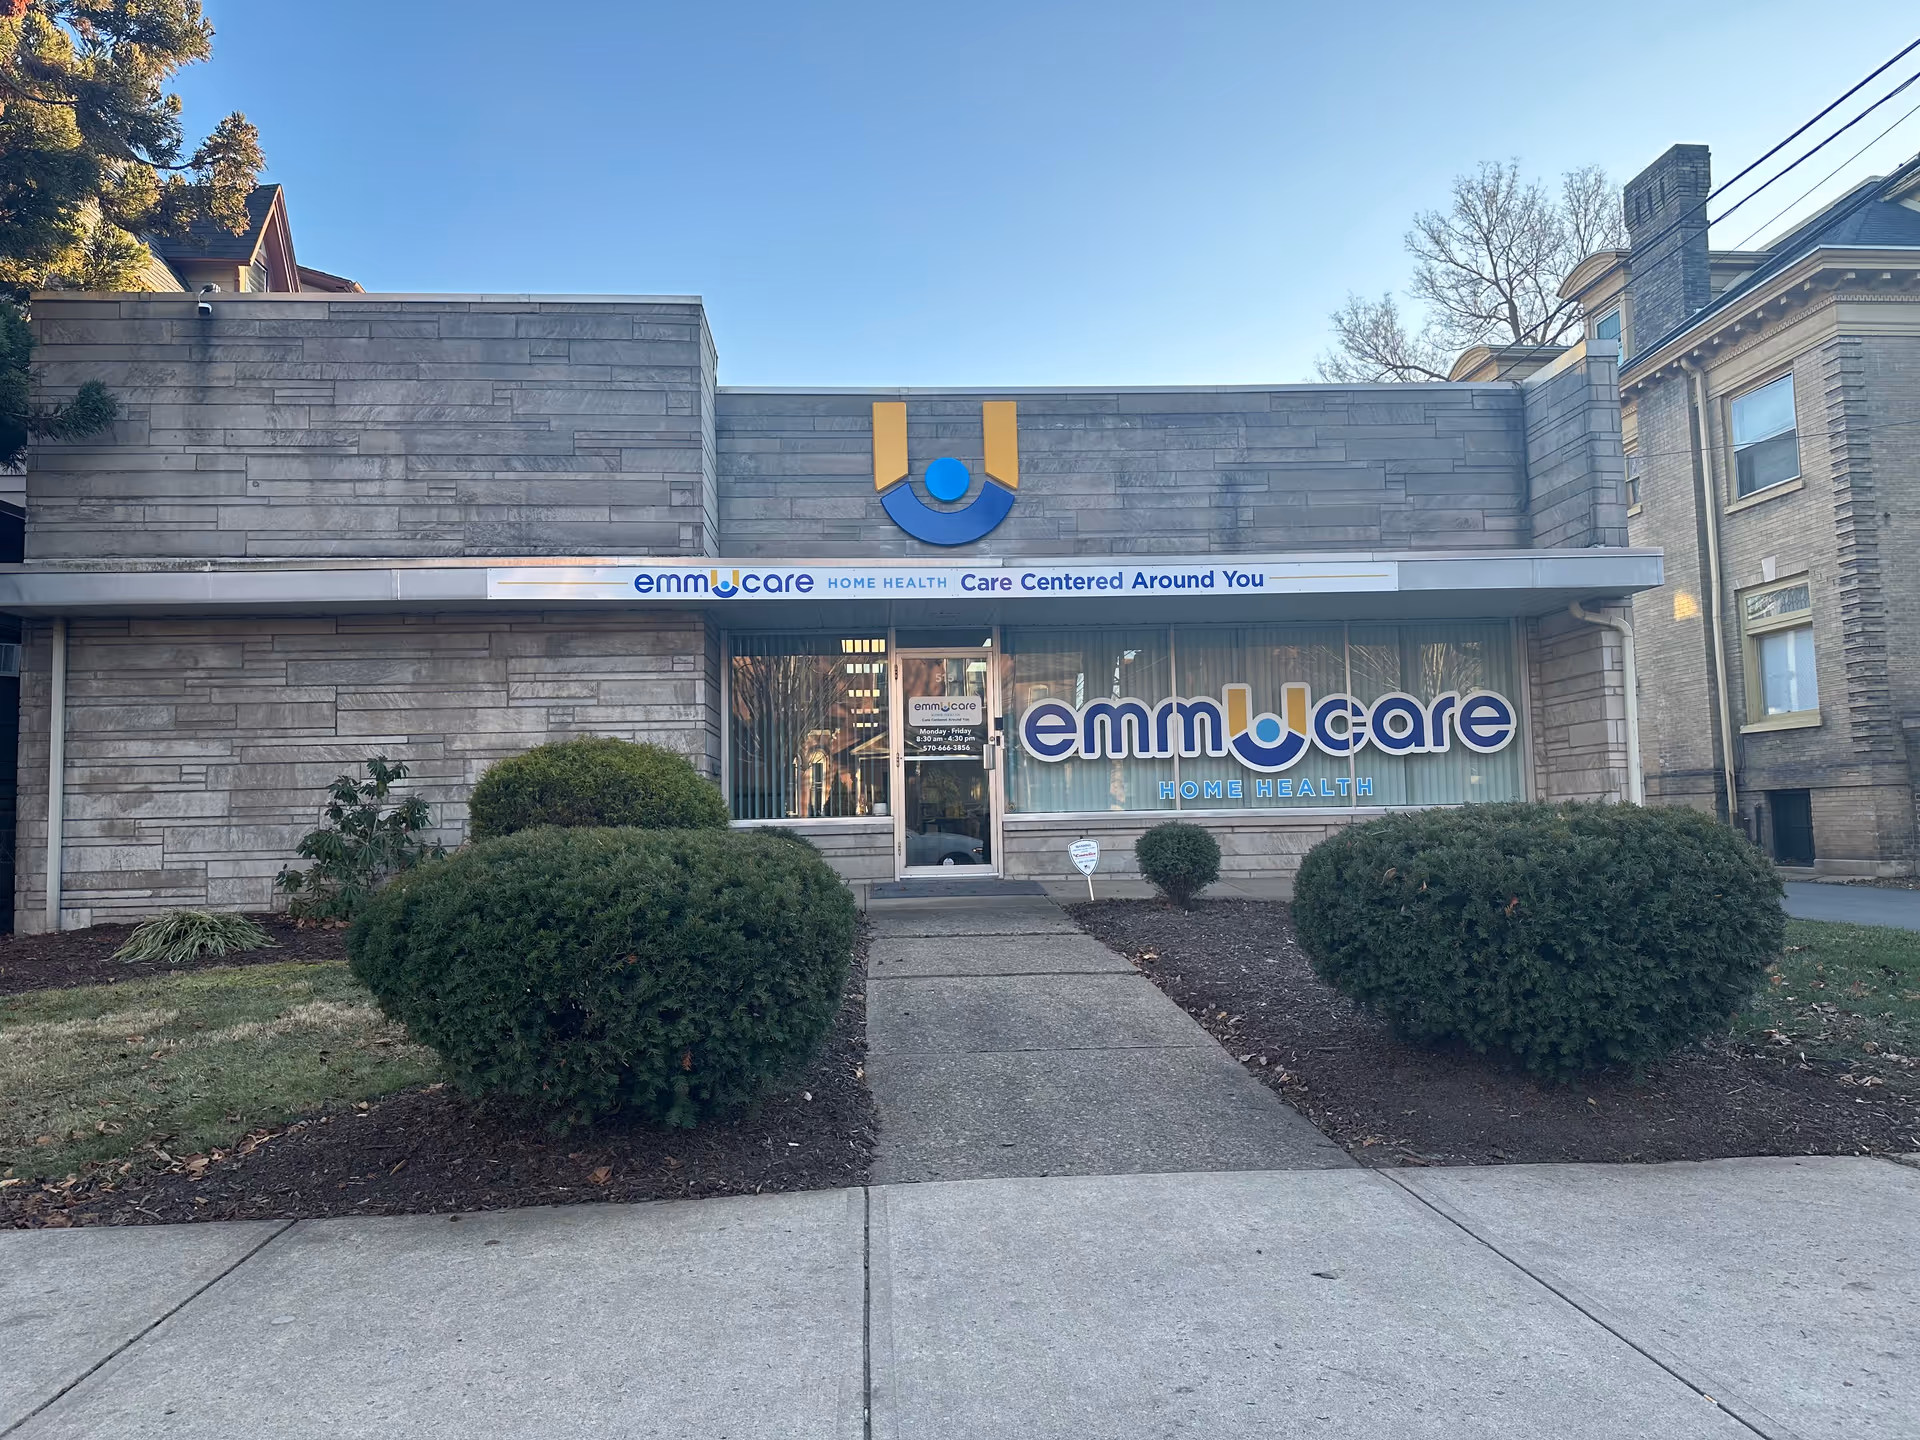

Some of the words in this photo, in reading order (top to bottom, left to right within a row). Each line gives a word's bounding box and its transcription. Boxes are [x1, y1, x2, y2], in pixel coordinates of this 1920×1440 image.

[828, 577, 876, 589] HOME
[883, 577, 947, 589] HEALTH
[960, 573, 1013, 592] Care
[1020, 571, 1124, 591] Centered
[1131, 570, 1215, 589] Around
[1222, 570, 1264, 588] You
[919, 728, 947, 736] Monday
[951, 728, 972, 736] Friday
[1158, 779, 1244, 800] HOME
[1256, 777, 1374, 798] HEALTH
